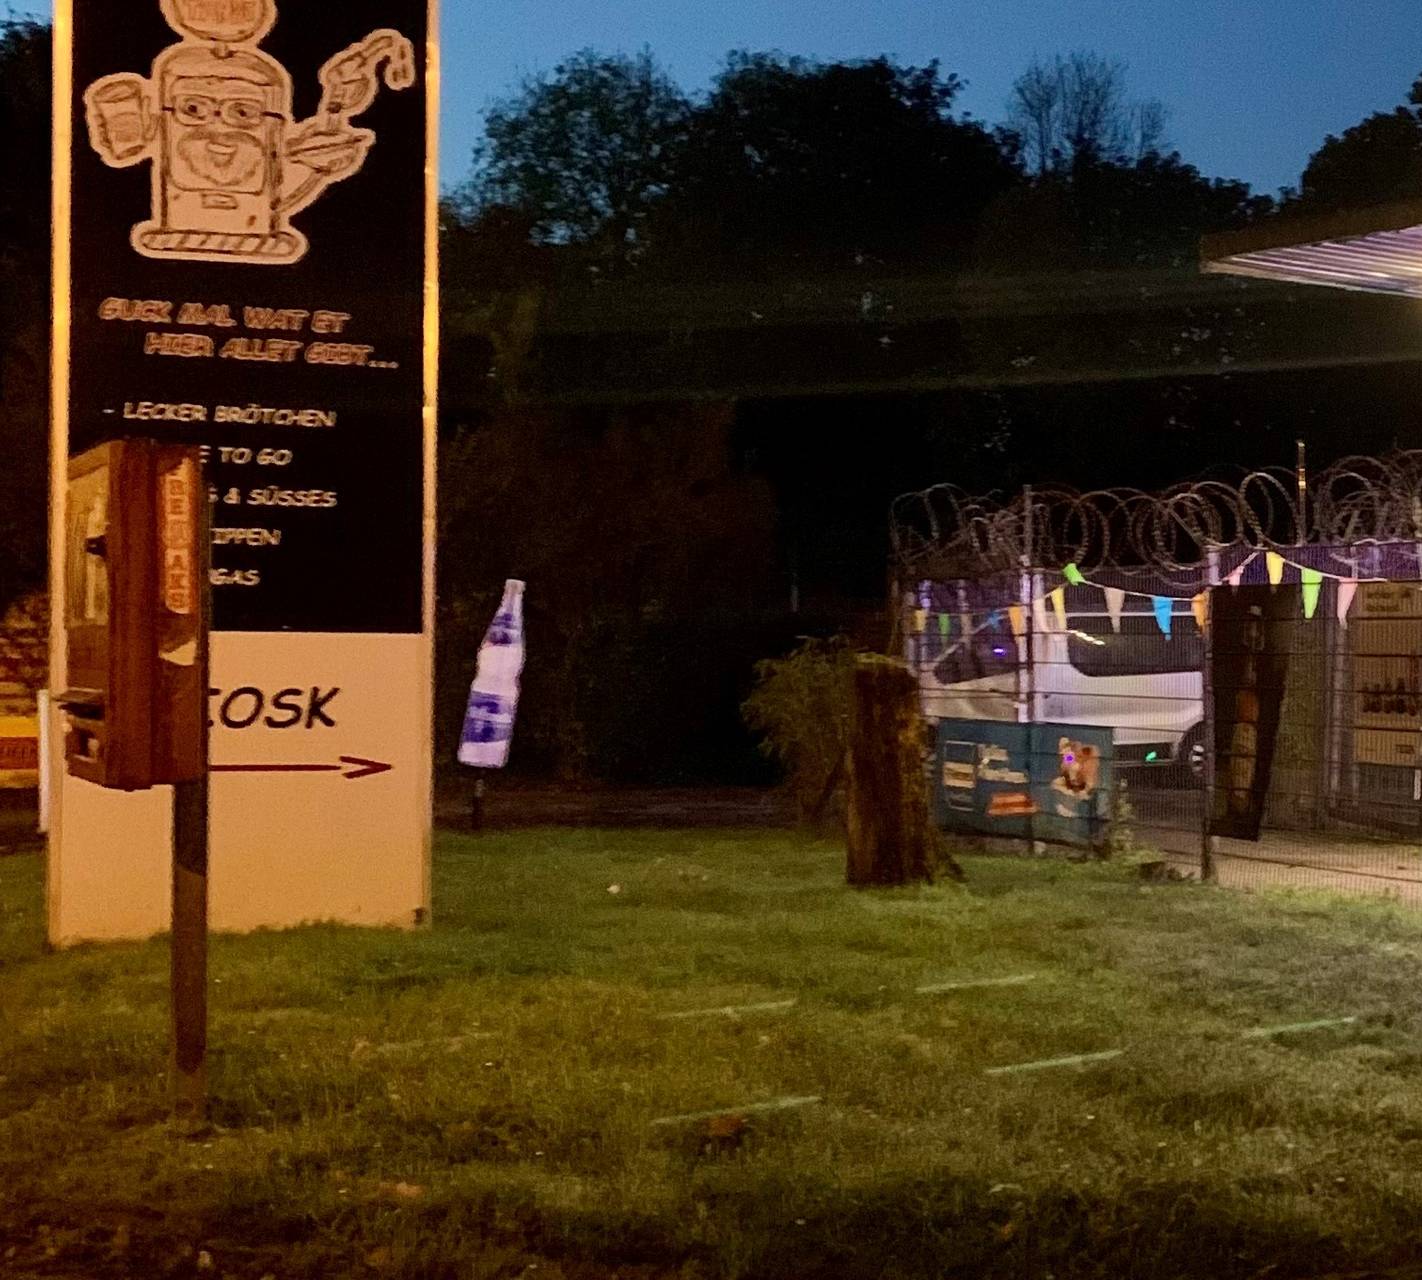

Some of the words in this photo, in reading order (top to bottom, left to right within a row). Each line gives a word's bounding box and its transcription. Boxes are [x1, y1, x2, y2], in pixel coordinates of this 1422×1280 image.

[98, 297, 173, 323] GUCK
[177, 302, 237, 327] MAL
[243, 306, 310, 330] WAT
[311, 310, 351, 333] ET
[144, 332, 214, 357] HIER
[219, 338, 304, 362] ALLET
[123, 402, 207, 422] LECKER
[214, 403, 337, 428] BRÖTCHEN
[218, 446, 252, 464] TO
[256, 448, 293, 465] GO
[223, 487, 241, 504] &
[247, 485, 338, 507] SÜSSES
[210, 527, 282, 546] IPPEN
